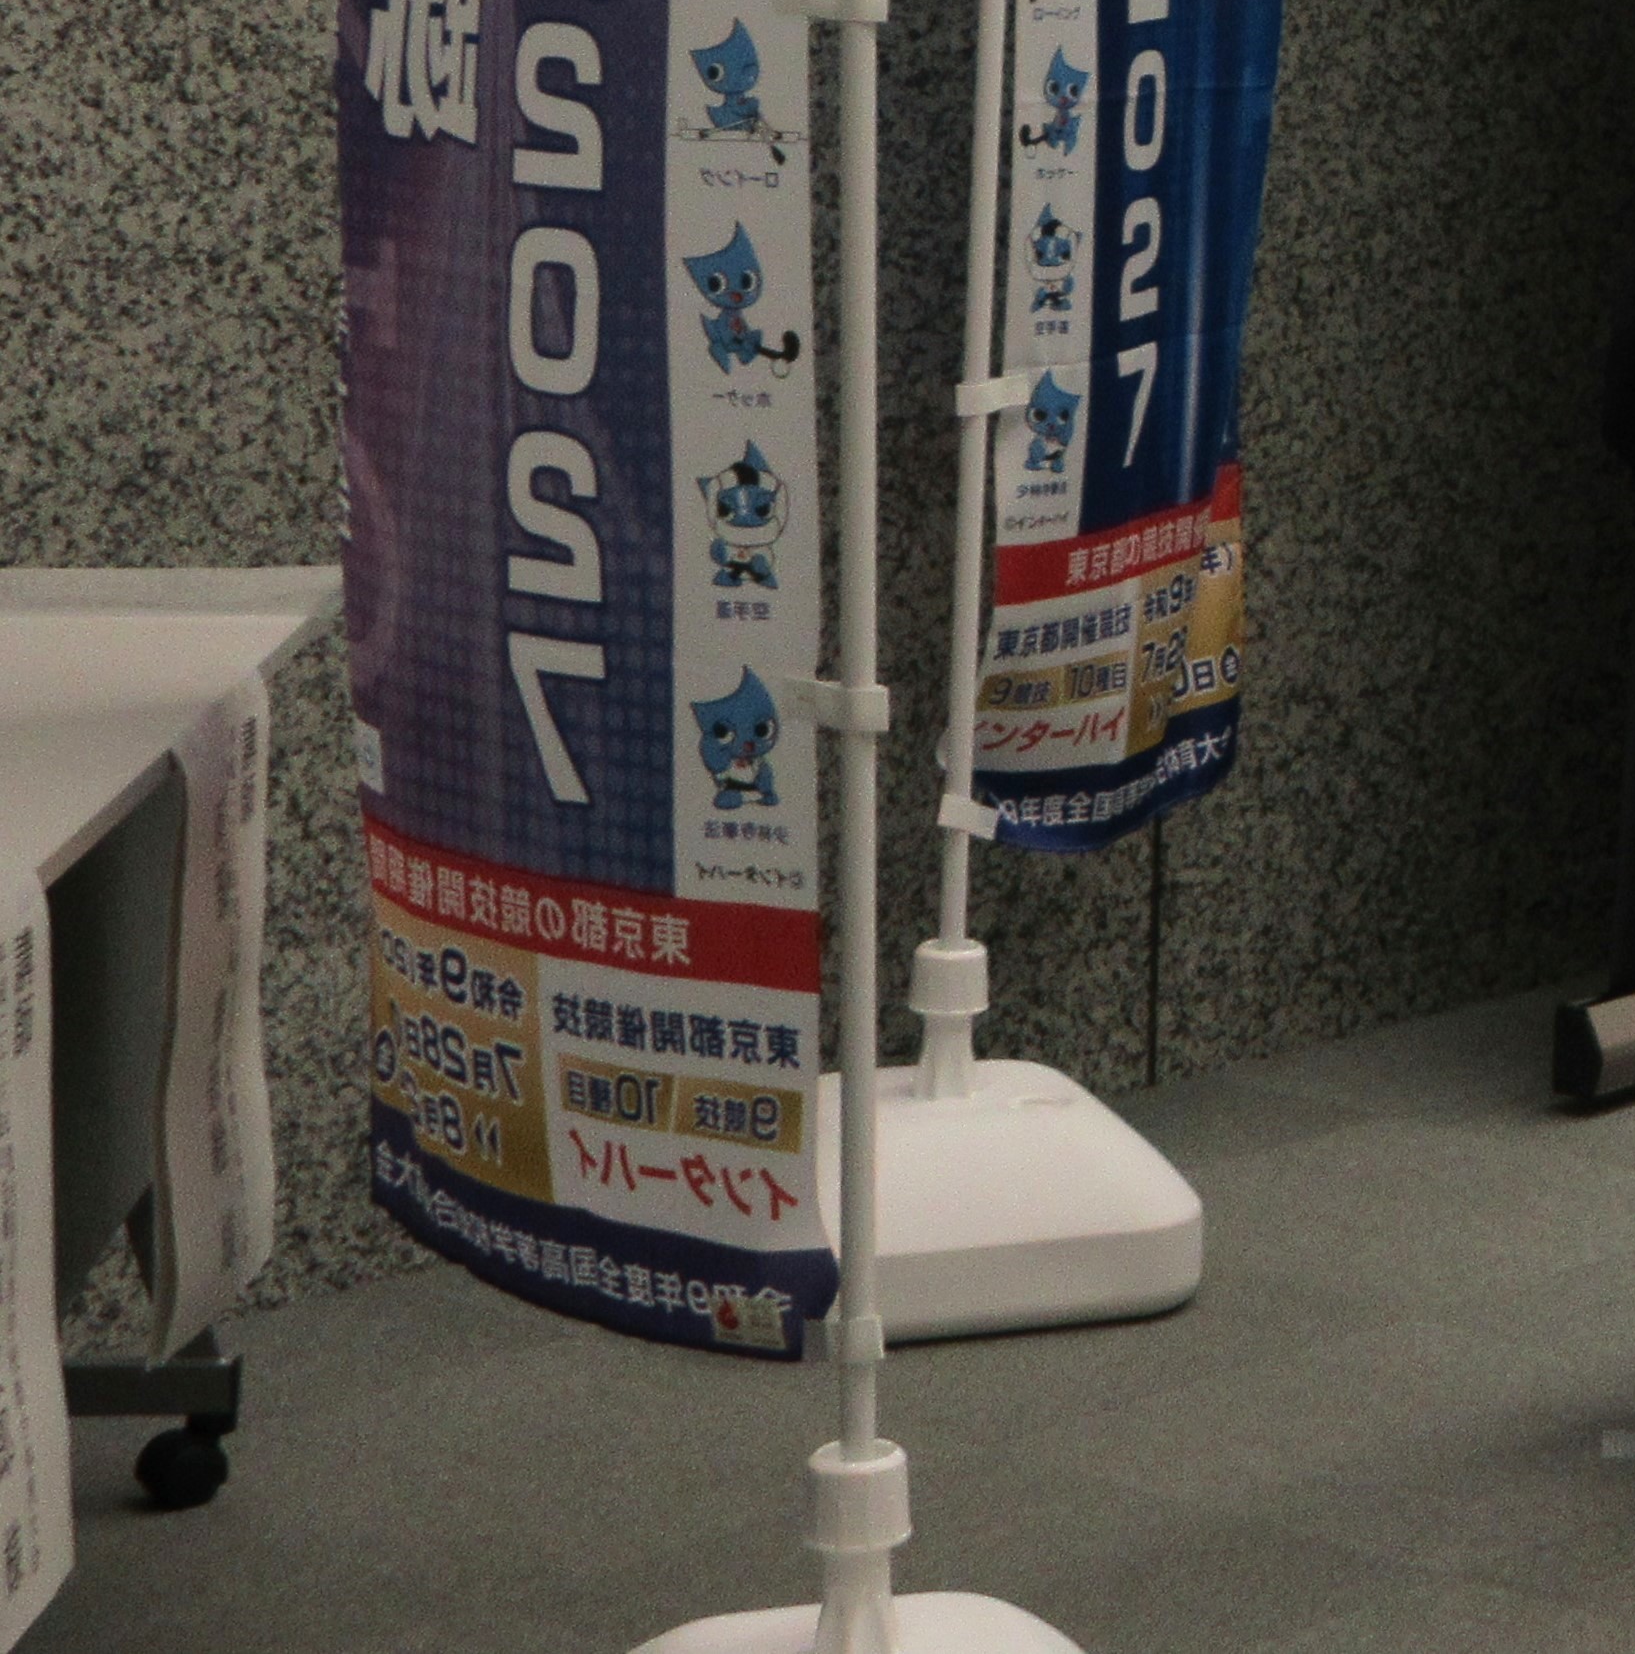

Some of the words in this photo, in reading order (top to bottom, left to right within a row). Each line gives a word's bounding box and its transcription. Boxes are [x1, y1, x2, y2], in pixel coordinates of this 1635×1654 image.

[974, 706, 1126, 754] ンターハイ
